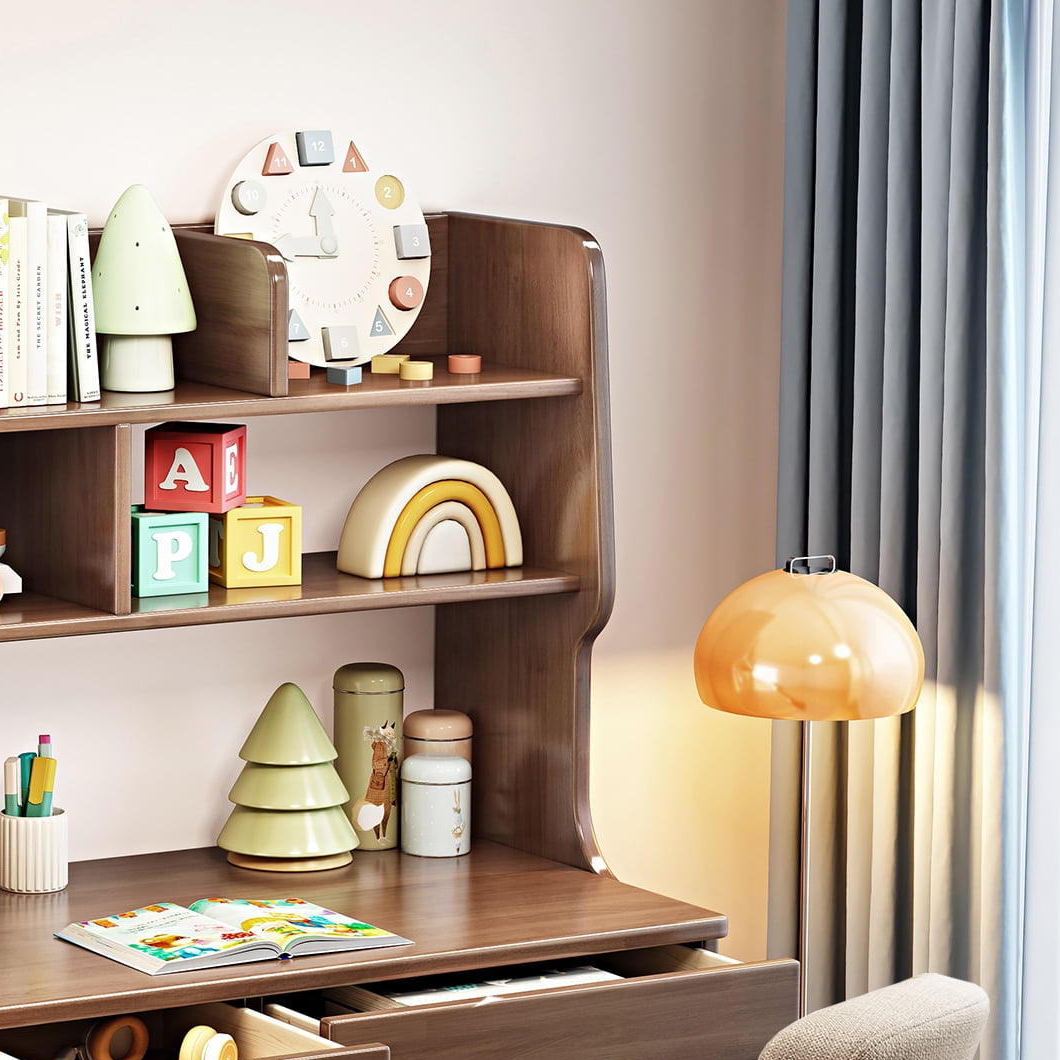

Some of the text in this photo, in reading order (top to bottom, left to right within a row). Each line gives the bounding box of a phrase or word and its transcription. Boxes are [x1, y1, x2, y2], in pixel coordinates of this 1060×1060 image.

[311, 141, 324, 152] 12
[275, 156, 287, 167] 11
[350, 157, 357, 169] 1
[245, 190, 259, 201] 10
[383, 187, 392, 199] 2
[412, 236, 420, 248] 3
[78, 256, 87, 299] ELEPHANT
[405, 287, 413, 297] 4
[293, 323, 300, 333] 7
[375, 320, 383, 333] 5
[340, 336, 348, 348] 6
[159, 447, 210, 492] A
[225, 442, 238, 495] E
[242, 523, 284, 572] J
[152, 531, 193, 580] P
